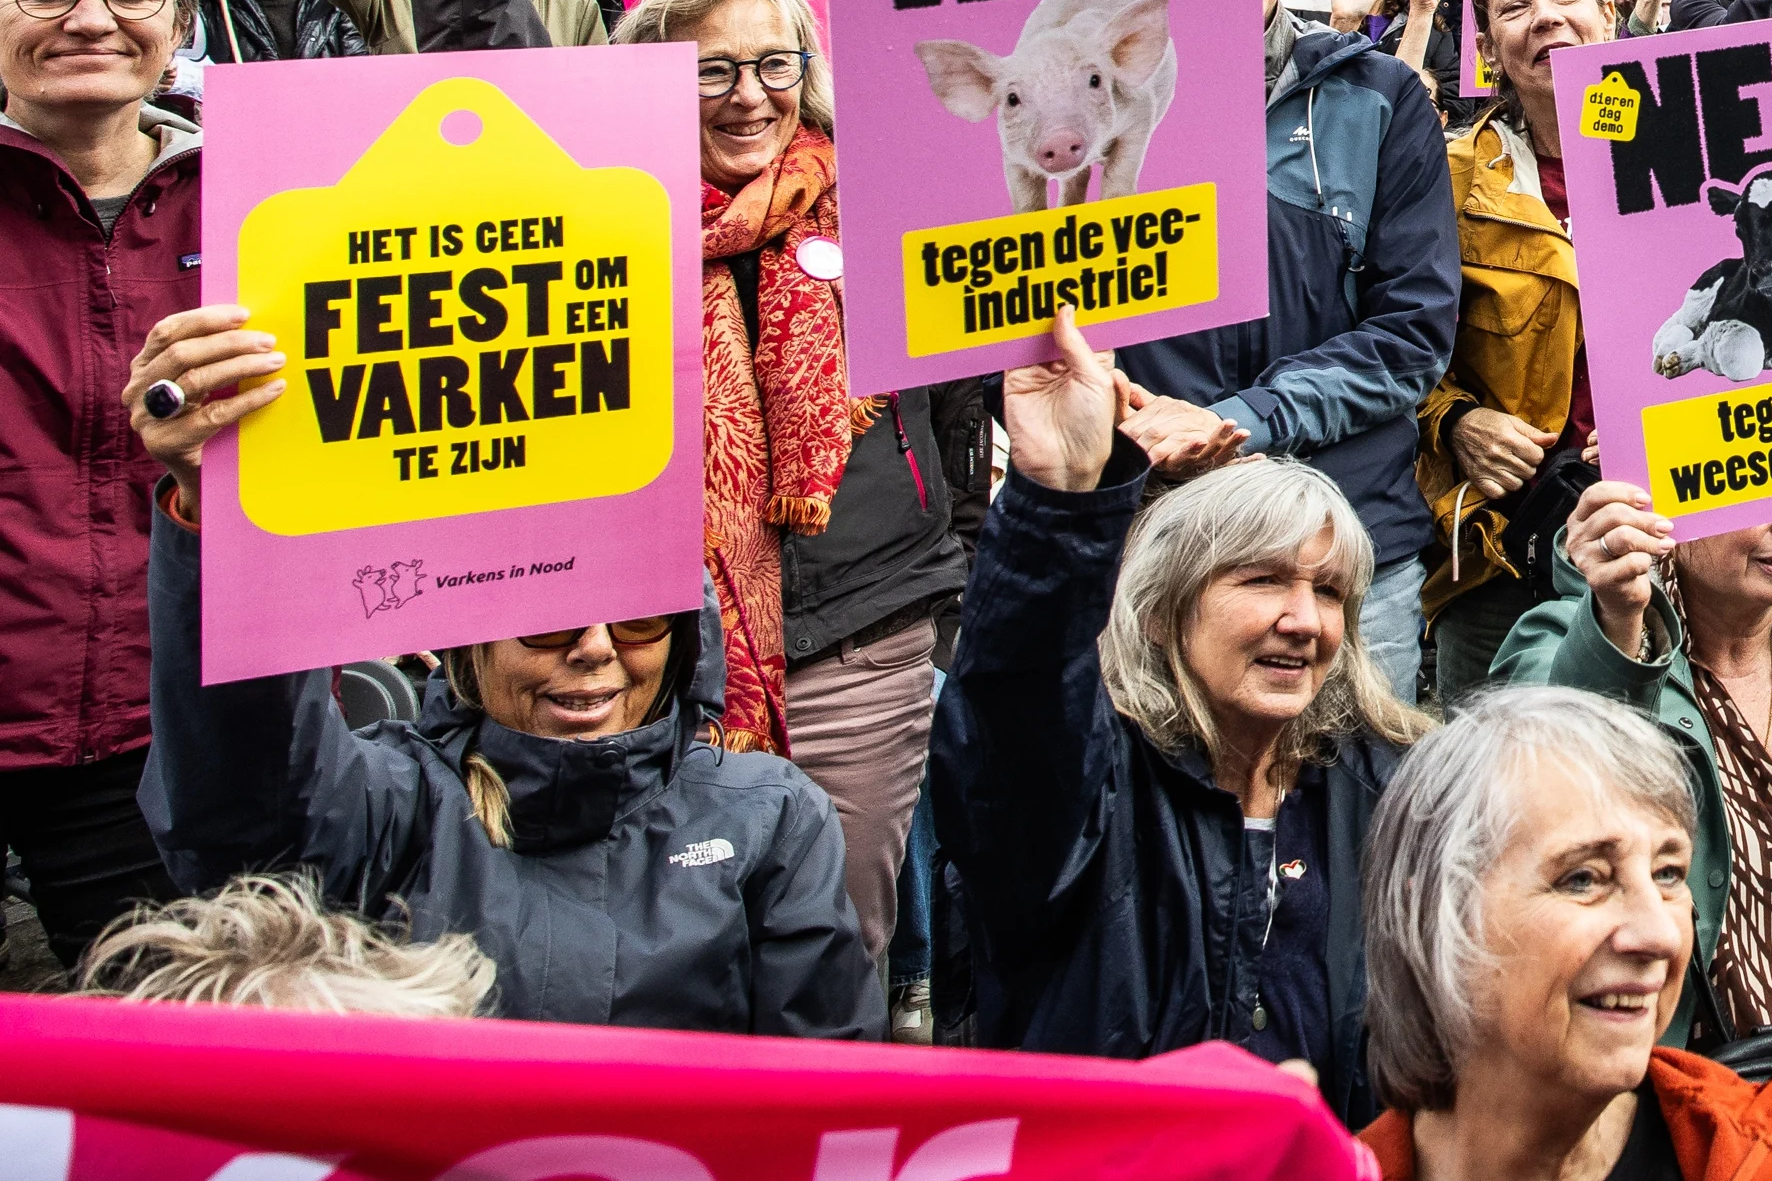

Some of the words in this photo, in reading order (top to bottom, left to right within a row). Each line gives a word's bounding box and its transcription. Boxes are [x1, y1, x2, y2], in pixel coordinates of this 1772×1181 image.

[1588, 91, 1635, 110] dieren
[1598, 105, 1623, 122] dag
[1592, 117, 1625, 135] demo
[347, 226, 425, 266] HET
[429, 223, 464, 256] IS
[475, 215, 565, 253] GEEN
[920, 227, 1048, 289] tegen
[1052, 214, 1105, 265] de
[1111, 206, 1202, 249] vee-
[302, 260, 563, 360] FEEST
[574, 255, 628, 291] OM
[962, 249, 1171, 335] industrie!
[566, 297, 629, 336] EEN
[305, 336, 631, 444] VARKEN
[391, 444, 438, 482] TE
[449, 433, 527, 476] ZIJN
[435, 565, 506, 590] Varkens
[508, 563, 526, 579] in
[529, 555, 575, 575] Nood
[669, 848, 712, 864] NORTH
[682, 856, 714, 868] FACE
[686, 840, 711, 853] THE
